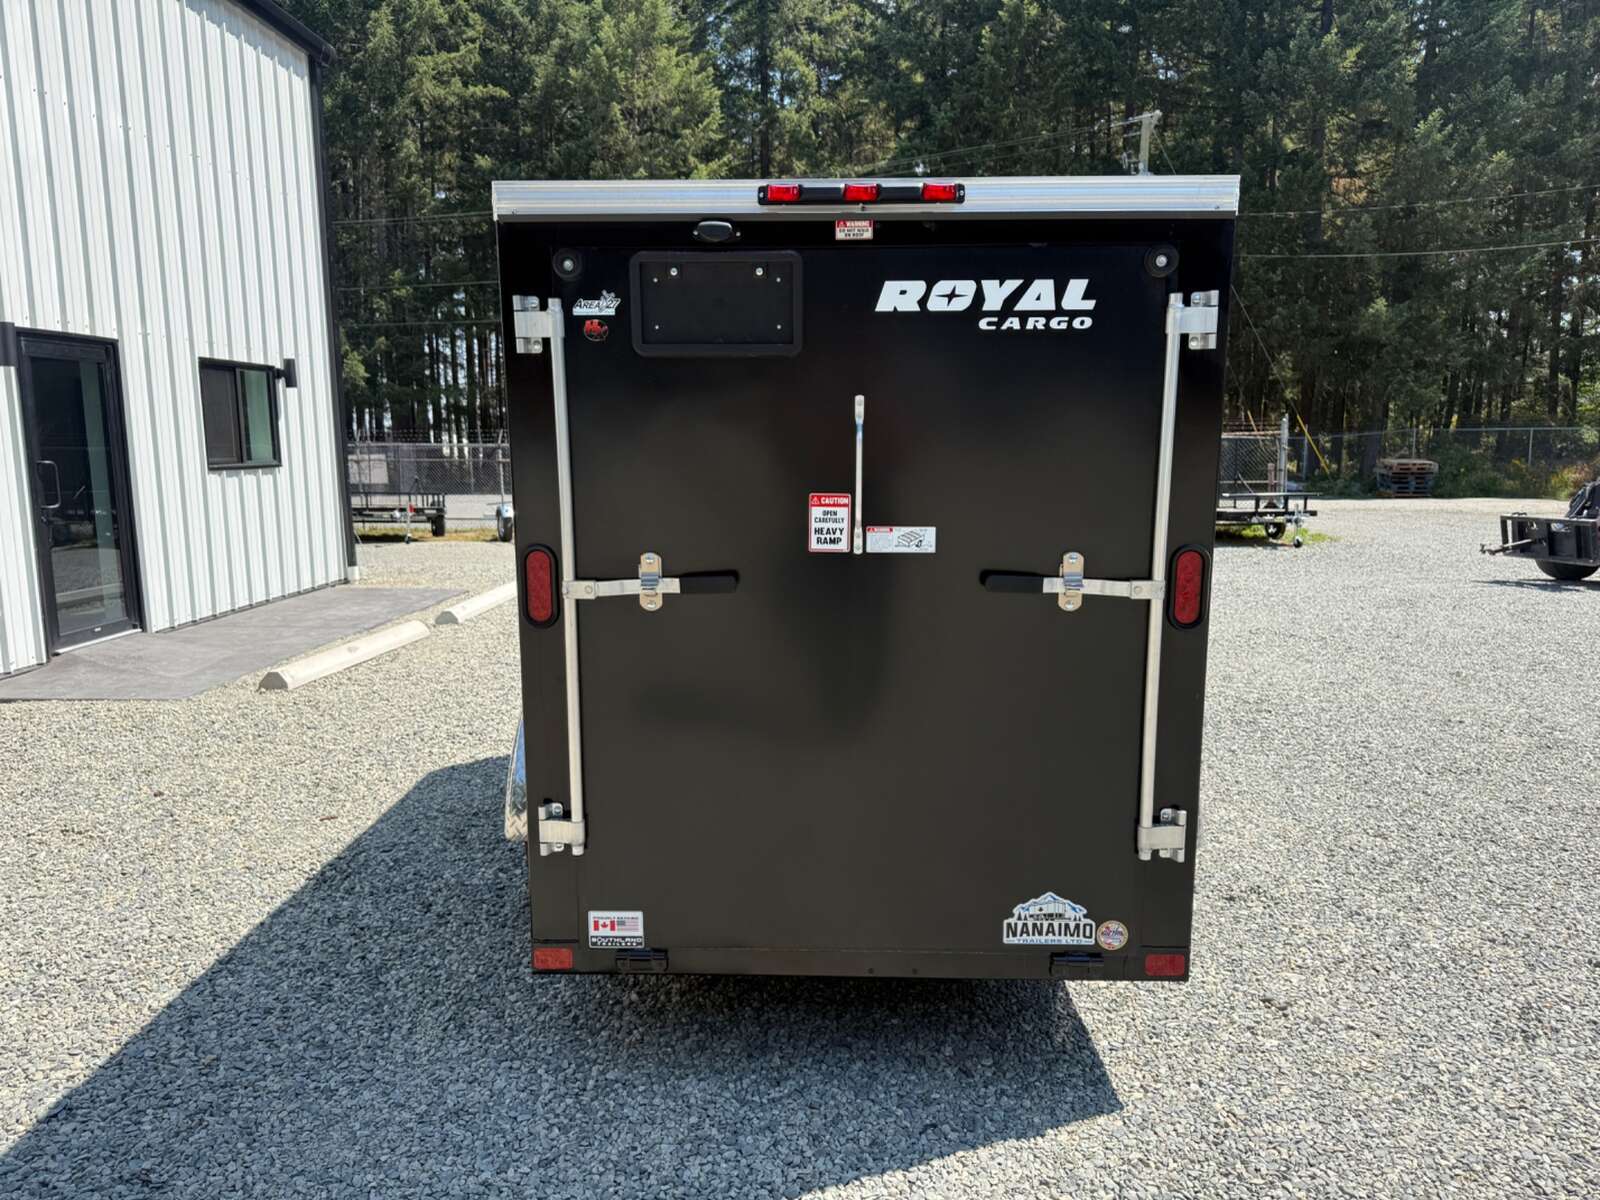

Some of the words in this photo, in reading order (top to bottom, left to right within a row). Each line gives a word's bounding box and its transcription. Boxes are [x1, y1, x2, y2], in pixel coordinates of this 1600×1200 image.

[874, 278, 1098, 312] ROYAL
[978, 316, 1093, 330] CARGO
[820, 496, 849, 505] CAUTION
[814, 527, 845, 535] HEAVY
[816, 537, 842, 545] RAMP
[1006, 922, 1094, 939] NANAIMO
